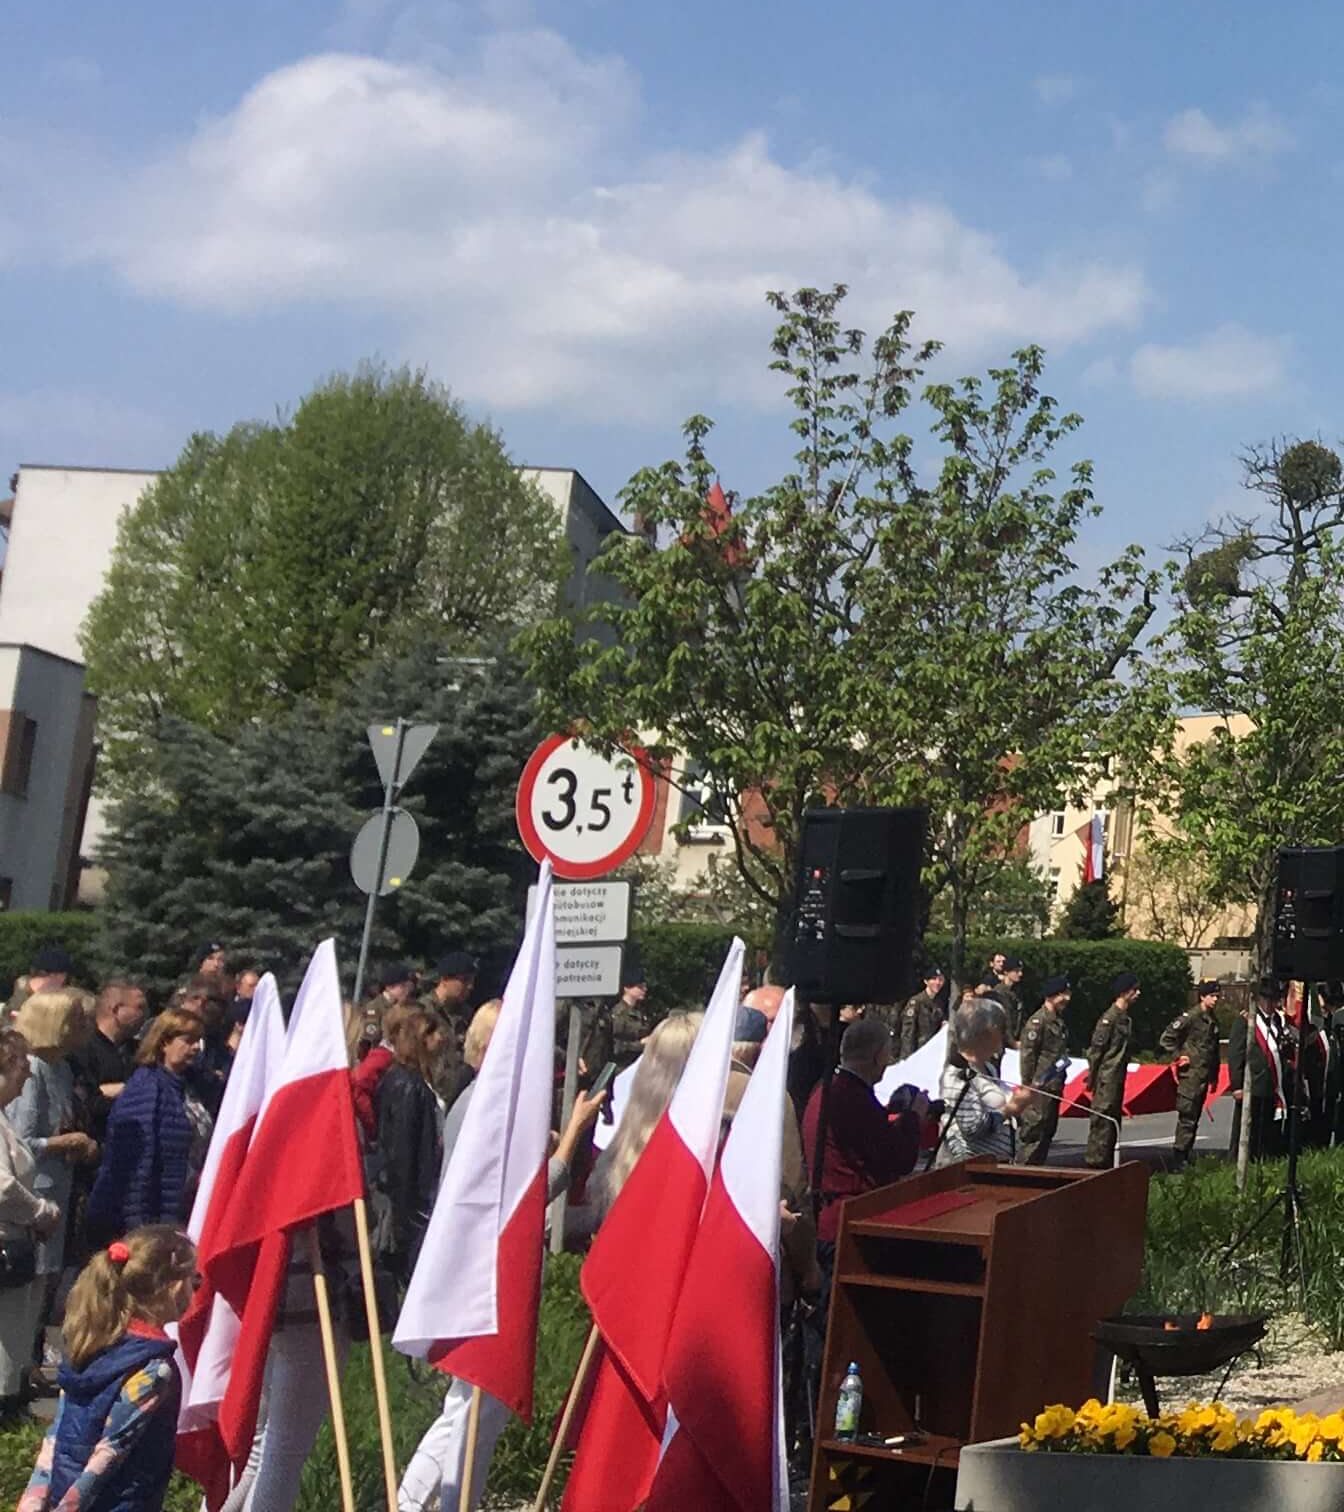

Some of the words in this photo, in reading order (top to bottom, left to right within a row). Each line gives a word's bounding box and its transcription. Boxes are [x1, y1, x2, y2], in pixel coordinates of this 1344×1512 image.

[542, 767, 611, 837] 3,5
[622, 770, 634, 805] t
[570, 887, 607, 897] dotyczy
[554, 912, 606, 923] omunikacji
[563, 959, 600, 970] dotyczy
[556, 973, 602, 985] patrzenia
